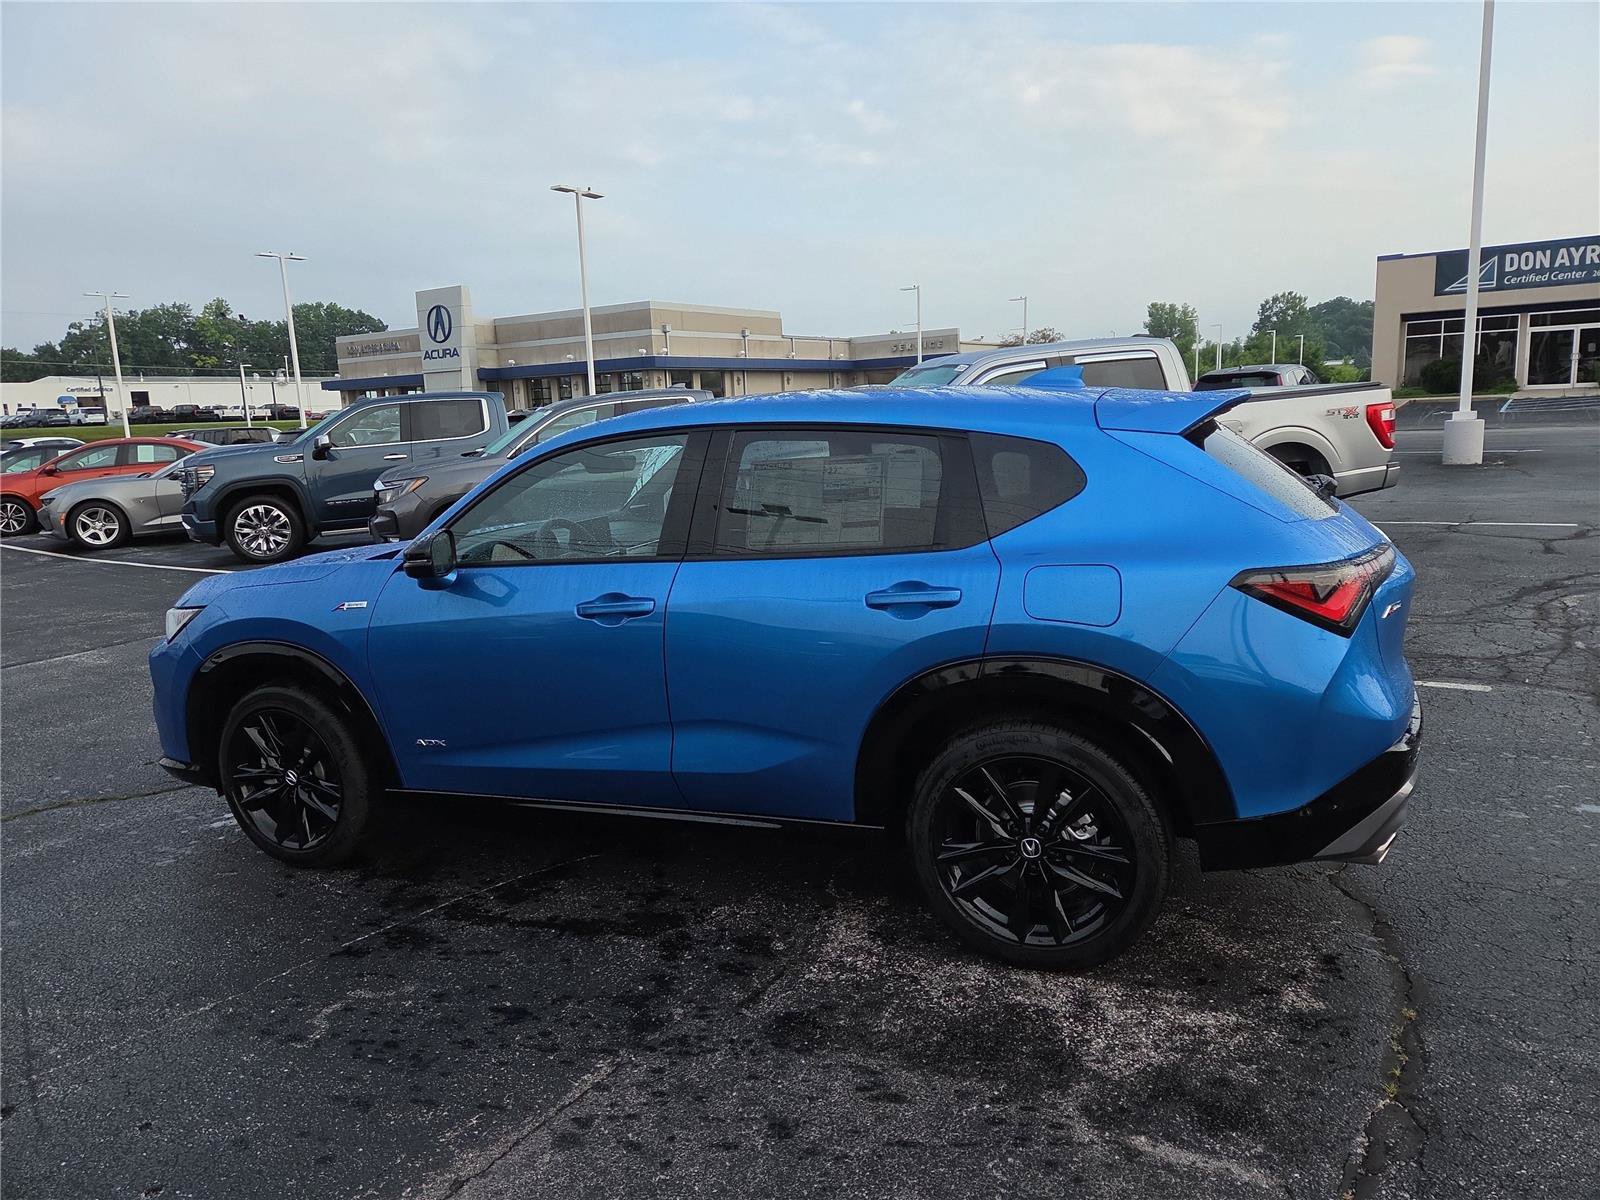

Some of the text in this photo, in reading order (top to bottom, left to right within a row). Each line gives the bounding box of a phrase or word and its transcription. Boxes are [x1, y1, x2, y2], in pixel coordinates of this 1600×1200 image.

[1505, 250, 1551, 272] DON
[1504, 272, 1549, 285] Certified
[1551, 270, 1587, 281] Center
[423, 347, 460, 360] ACURA
